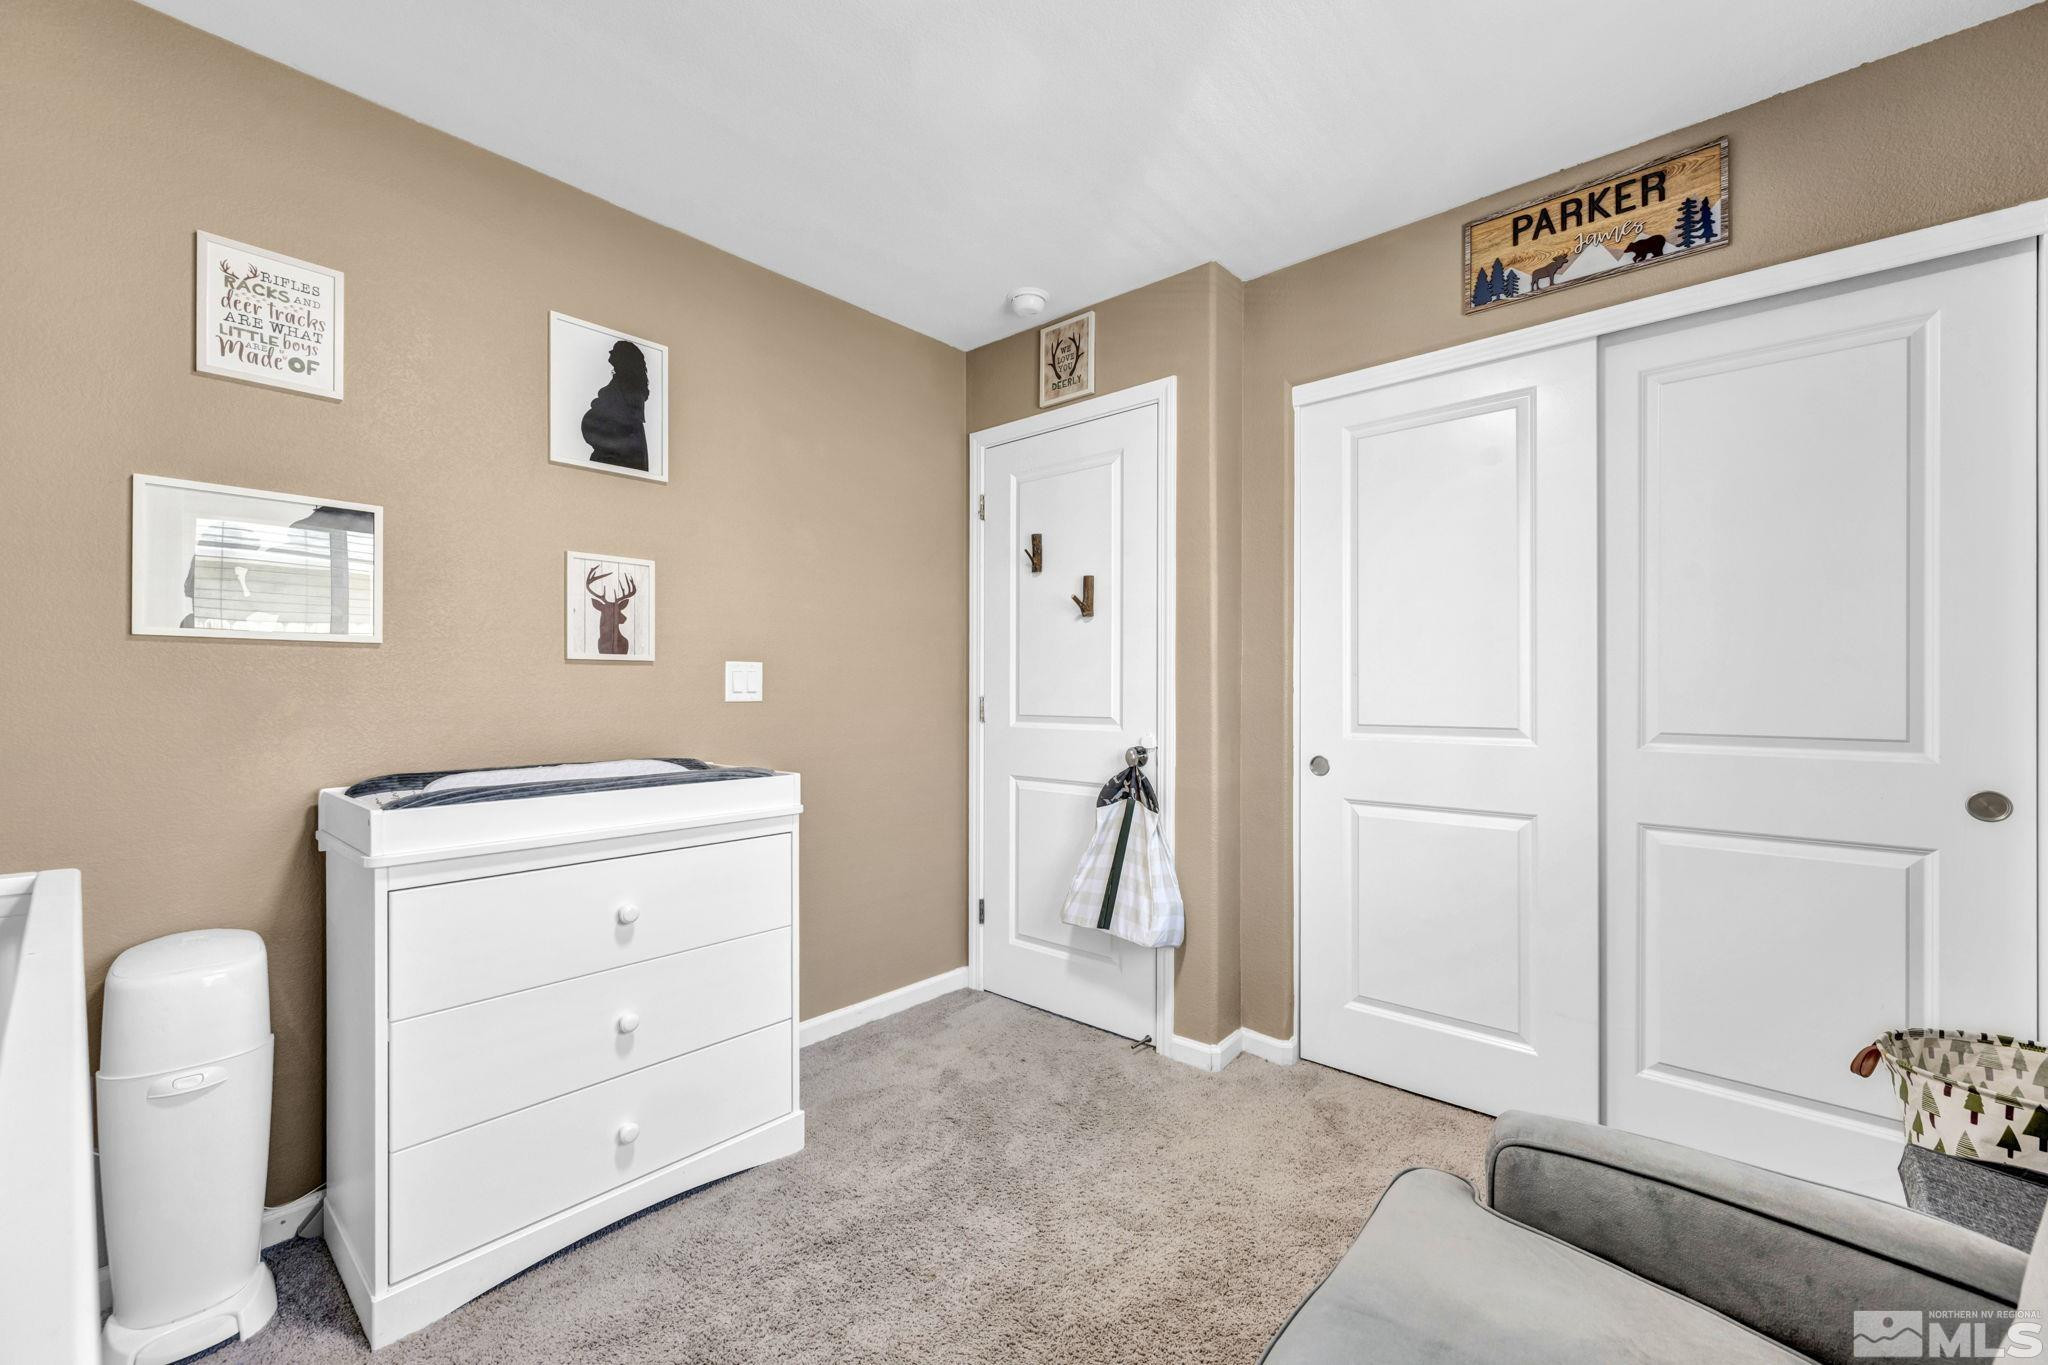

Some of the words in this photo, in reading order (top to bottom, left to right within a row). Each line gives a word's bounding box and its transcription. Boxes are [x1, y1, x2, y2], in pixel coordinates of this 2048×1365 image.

[1512, 170, 1666, 246] PARKER
[224, 275, 291, 303] RACKS
[294, 296, 321, 309] AND
[260, 271, 321, 297] RIFLES
[221, 289, 263, 316] deer
[267, 302, 326, 333] tracks
[223, 312, 264, 330] ARE
[269, 321, 323, 345] WHAT
[219, 323, 279, 347] LITTLE
[283, 333, 319, 357] boys
[245, 343, 269, 353] ARE
[1060, 345, 1072, 354] WE
[288, 357, 320, 376] OF
[1057, 352, 1075, 364] LOVE
[1058, 362, 1073, 373] YOU
[1052, 374, 1082, 391] DEERLY
